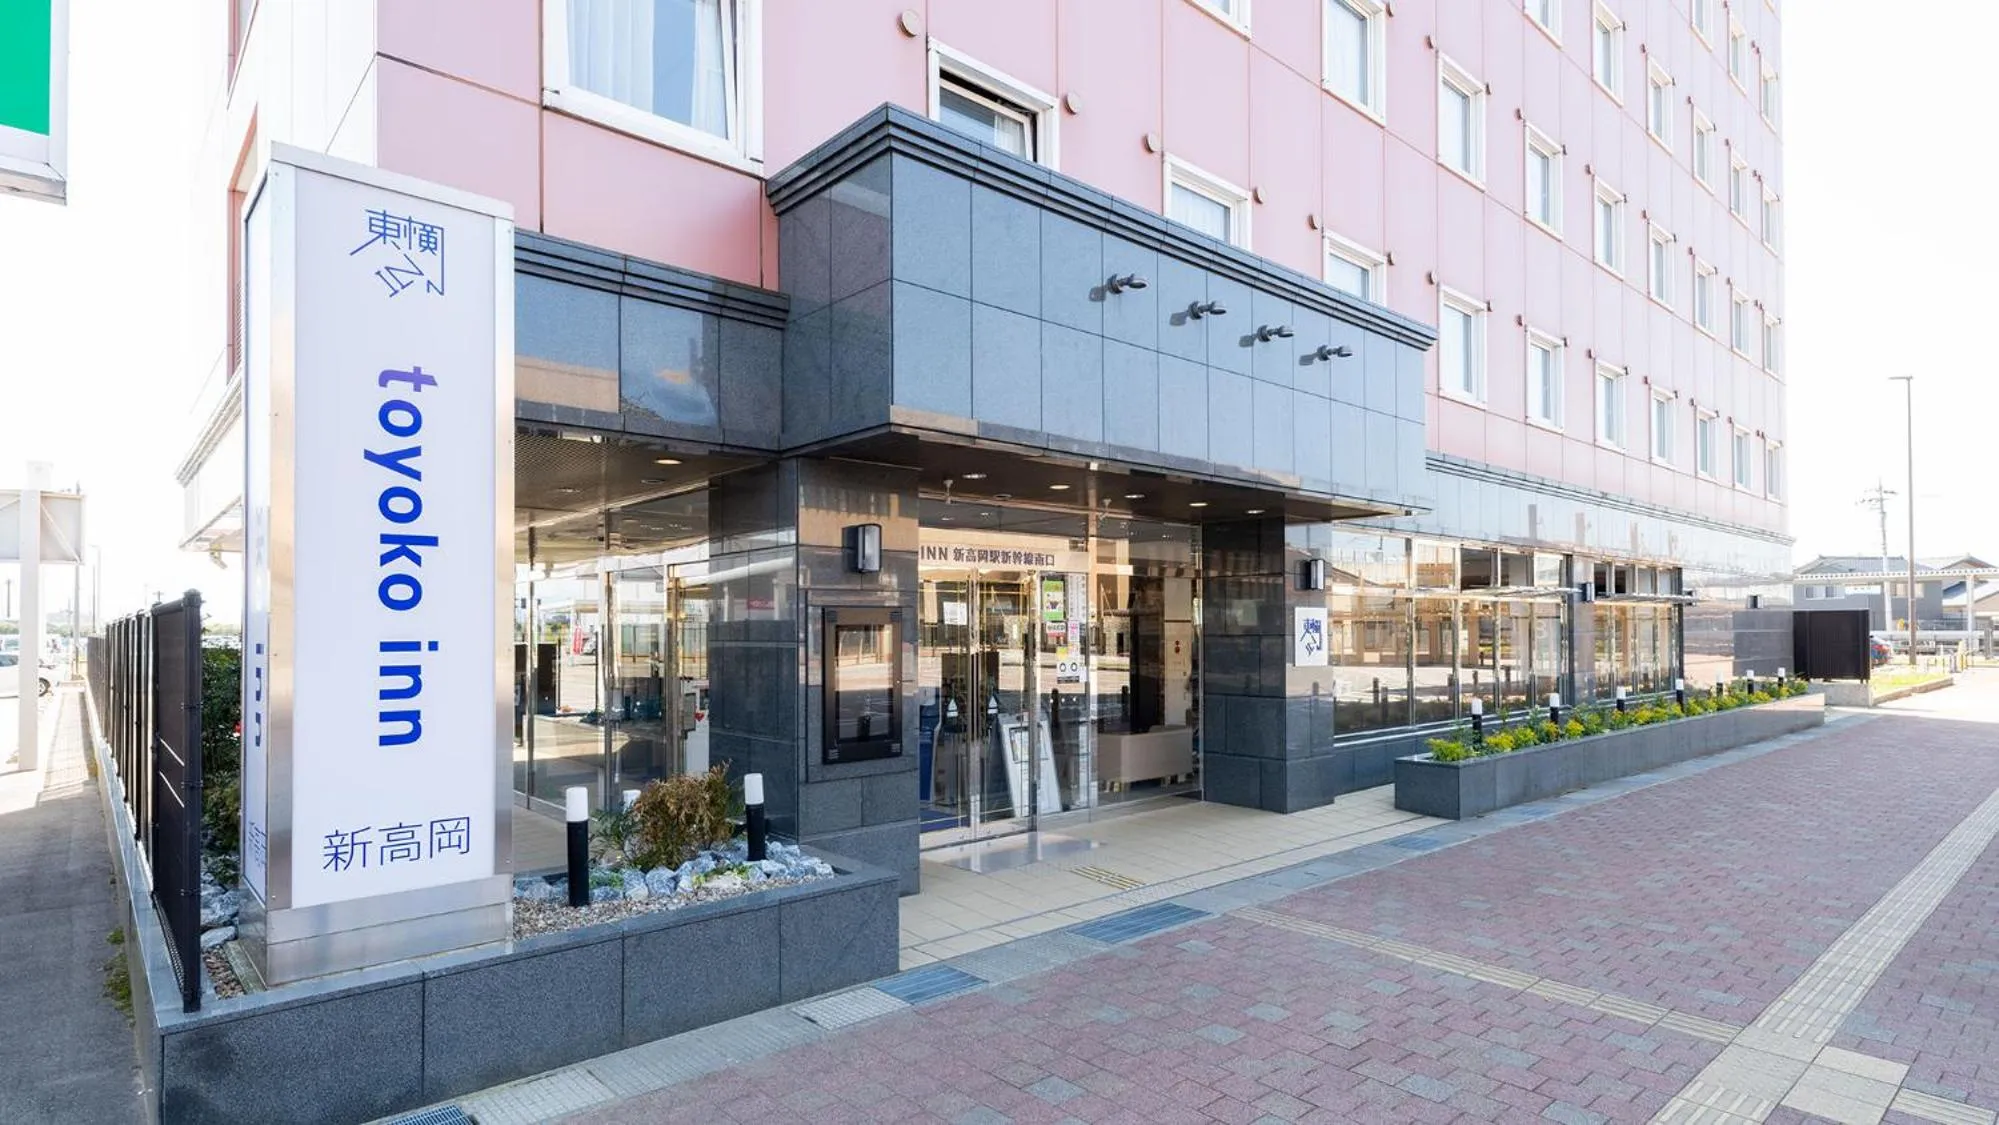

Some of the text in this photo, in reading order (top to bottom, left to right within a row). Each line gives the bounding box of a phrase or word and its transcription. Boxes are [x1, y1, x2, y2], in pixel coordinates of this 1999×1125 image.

[364, 366, 439, 748] toyoko inn
[920, 545, 949, 560] INN
[323, 816, 470, 872] 新高岡
